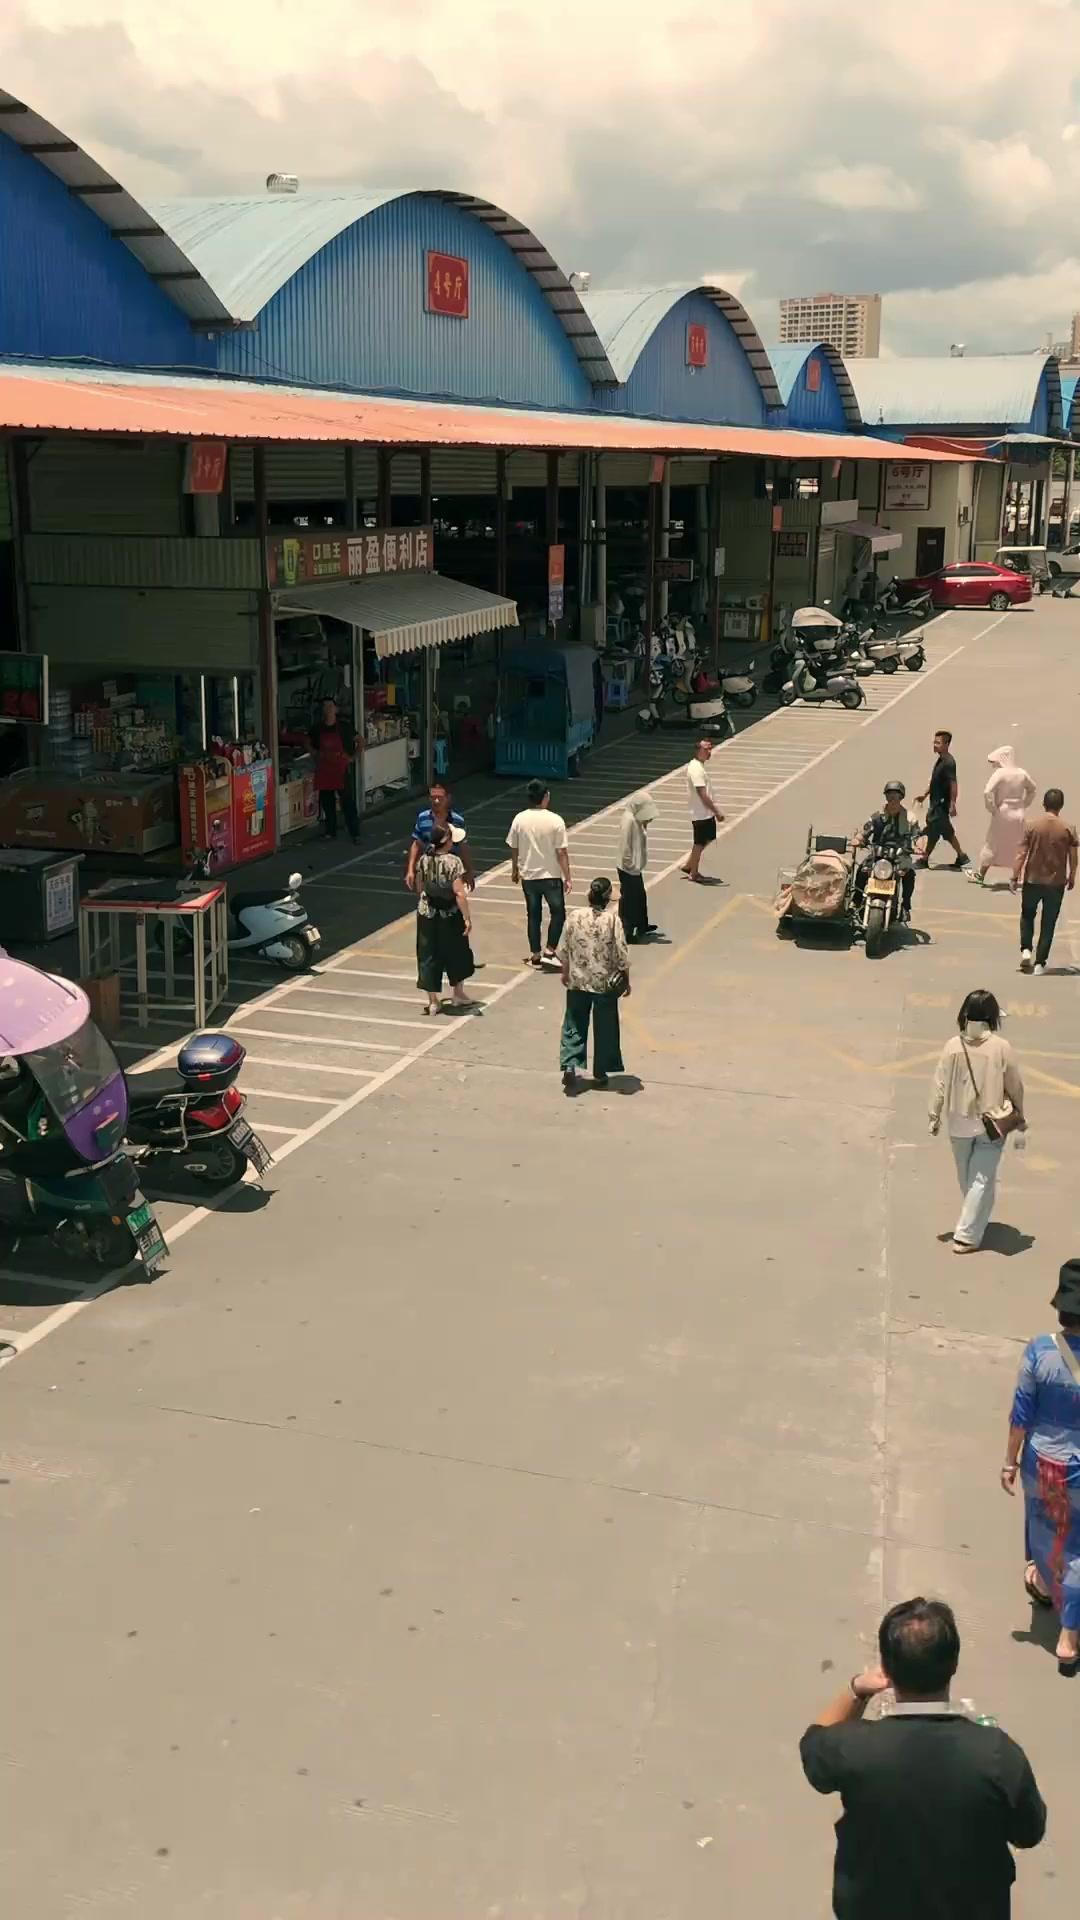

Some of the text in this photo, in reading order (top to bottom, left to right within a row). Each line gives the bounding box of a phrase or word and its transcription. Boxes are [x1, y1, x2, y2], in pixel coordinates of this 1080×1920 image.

[346, 530, 428, 577] 丽盈便利店
